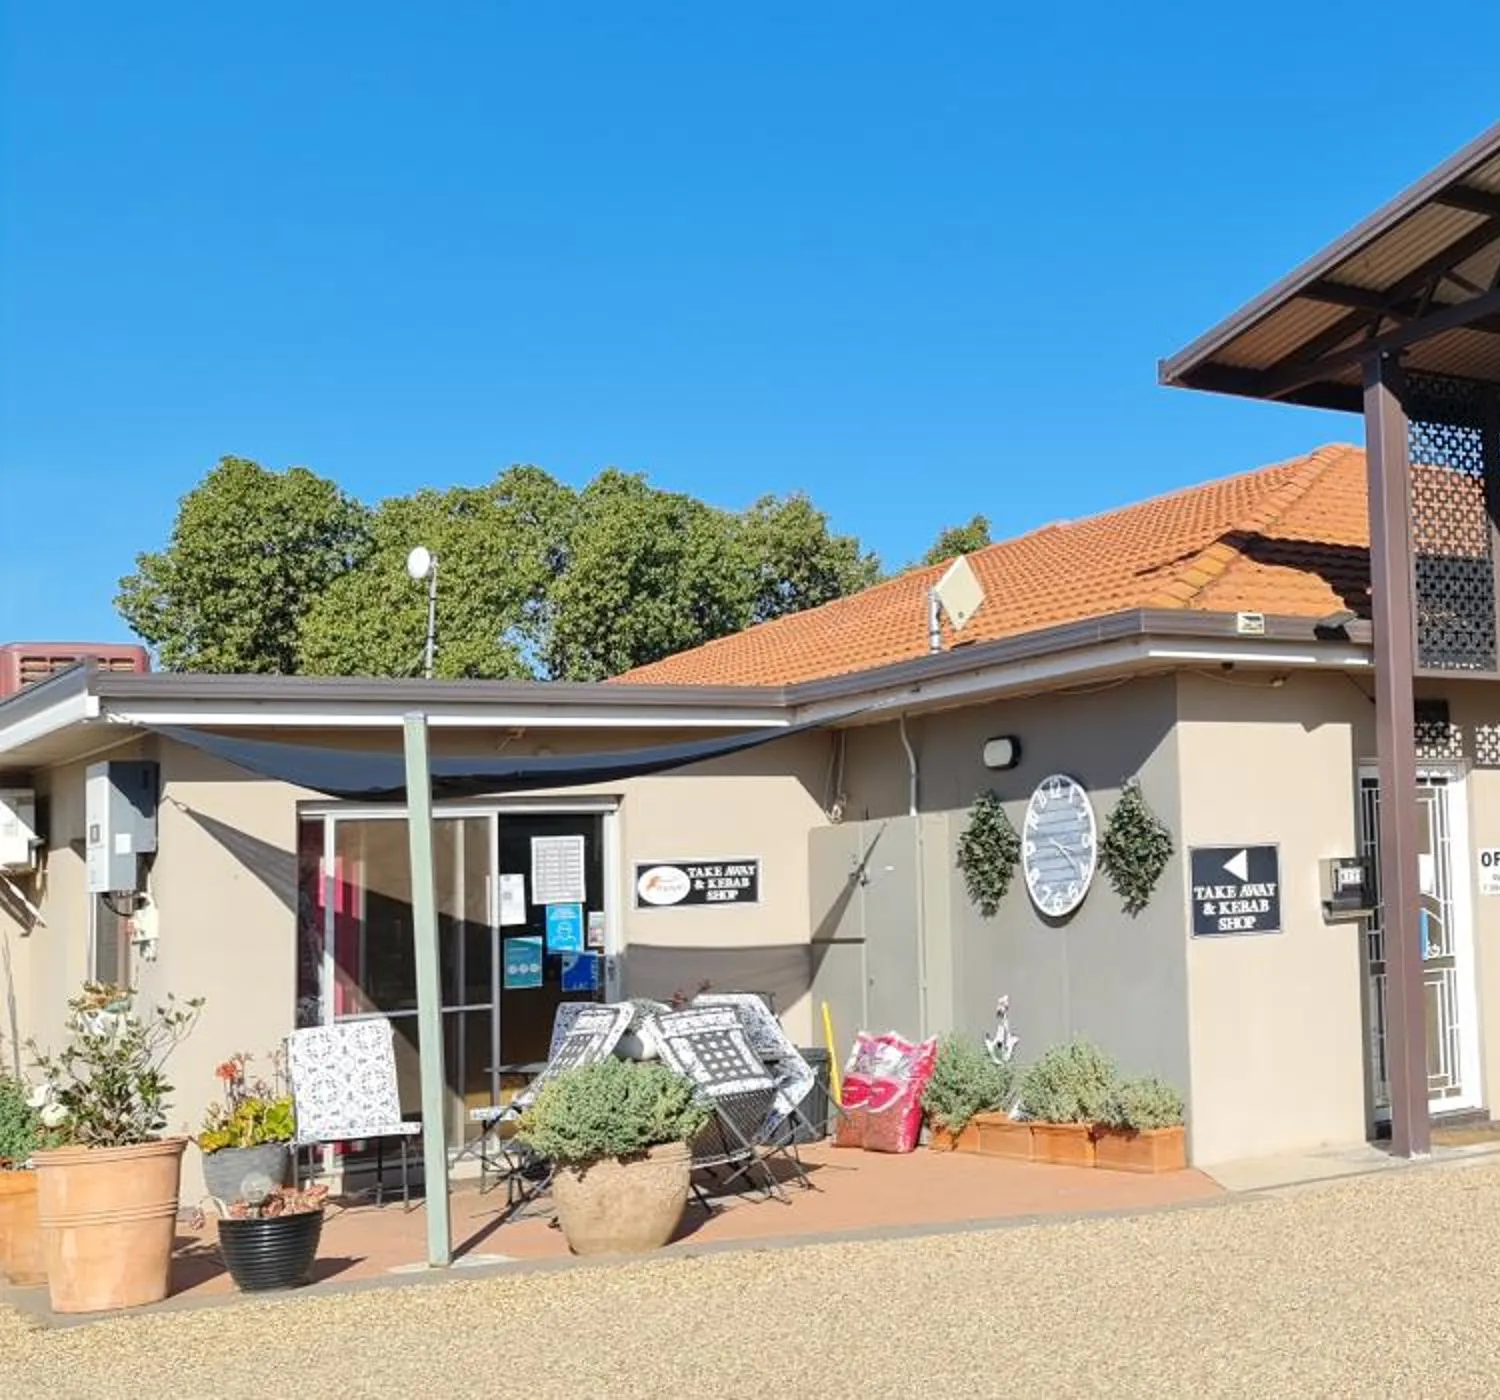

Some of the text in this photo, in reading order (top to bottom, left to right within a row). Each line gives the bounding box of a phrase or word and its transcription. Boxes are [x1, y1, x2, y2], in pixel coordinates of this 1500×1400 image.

[687, 865, 756, 878] TAKE AWAY
[694, 879, 706, 890] &
[707, 877, 750, 889] KEBAB
[706, 889, 739, 901] SHOP
[1194, 883, 1276, 900] TAKE AWAY
[1203, 899, 1270, 916] & KEBAB
[1218, 915, 1257, 931] SHOP
